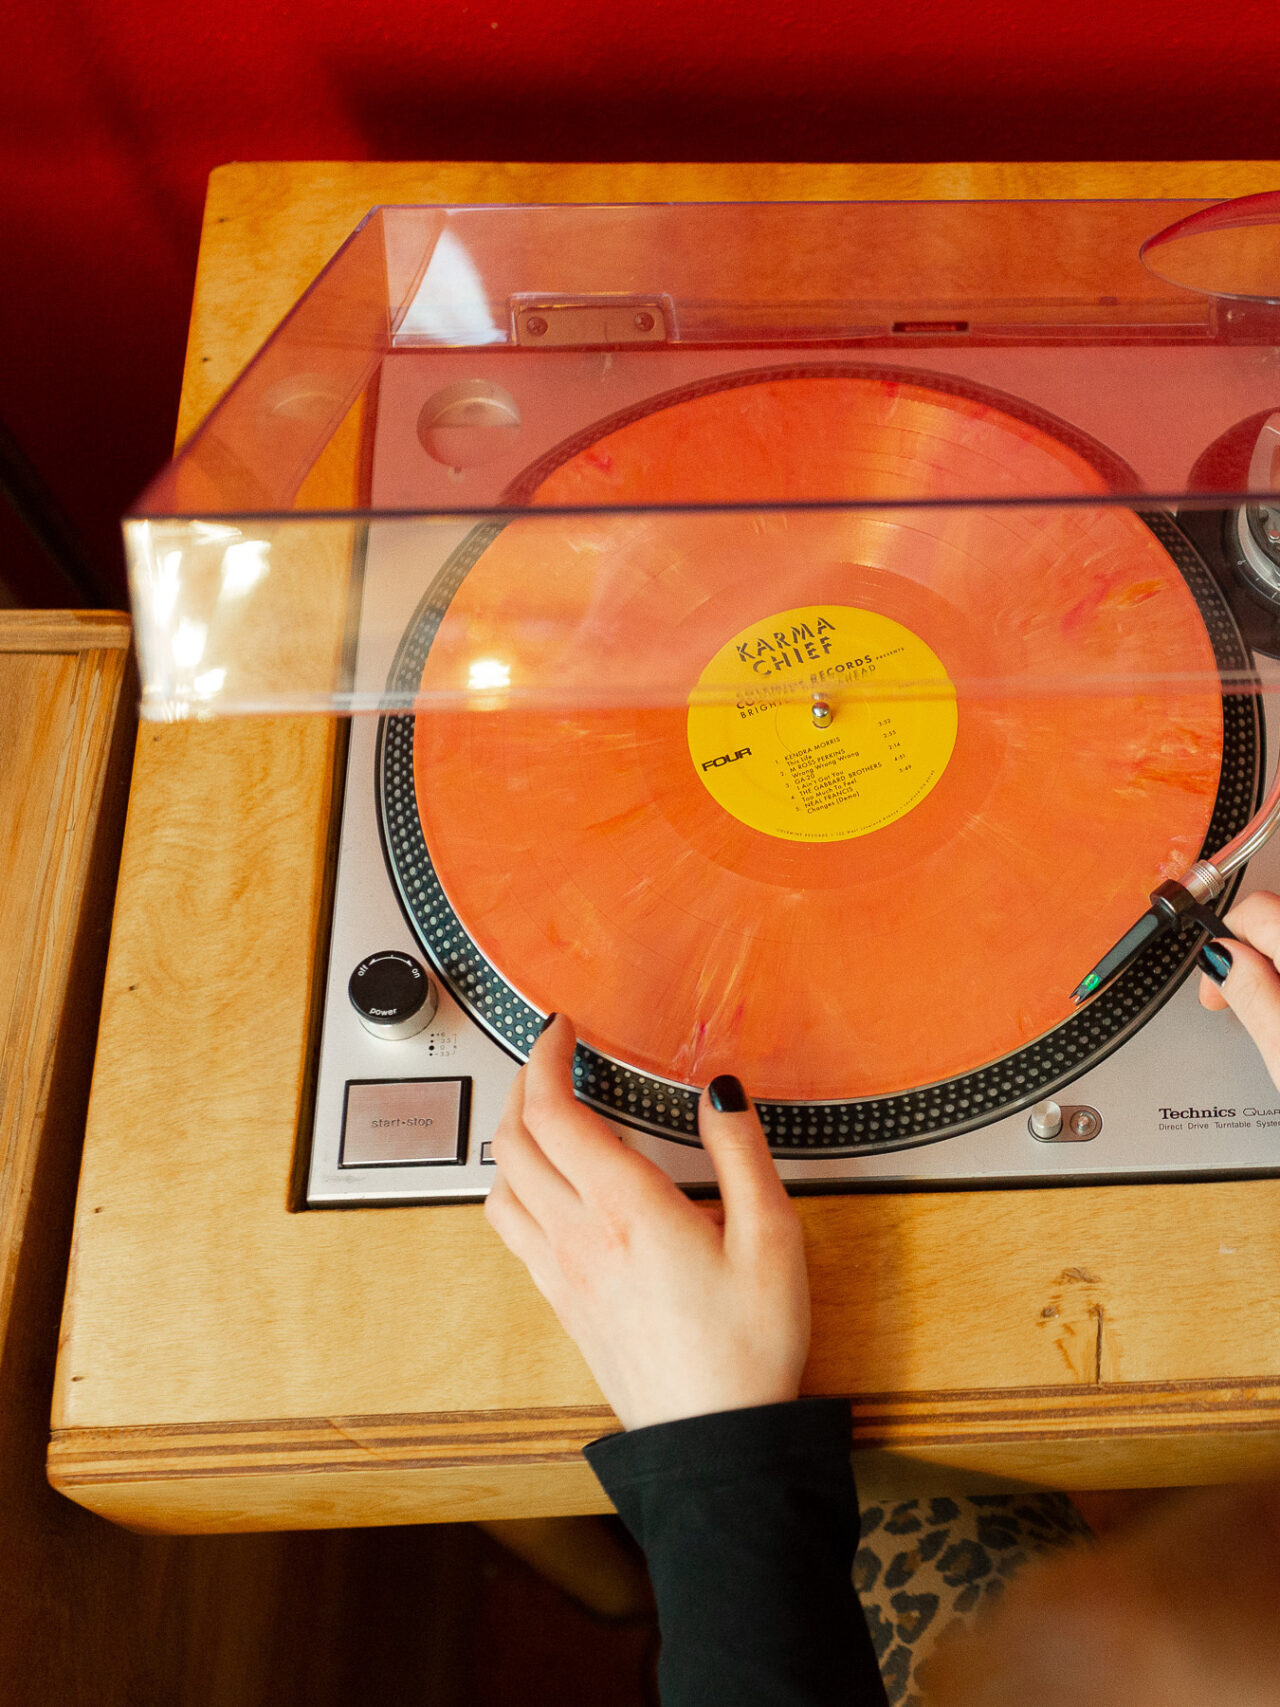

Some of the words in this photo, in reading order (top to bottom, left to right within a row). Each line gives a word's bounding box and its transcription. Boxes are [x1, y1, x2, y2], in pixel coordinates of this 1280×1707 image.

[736, 617, 836, 662] KARMA
[752, 636, 832, 676] CHIEF
[810, 655, 873, 683] RECORDS
[784, 747, 812, 760] KENDRA
[814, 737, 840, 750] MORRIS
[798, 759, 816, 769] ROSS
[817, 749, 845, 762] PERKINS
[702, 748, 752, 772] FOUR
[792, 768, 813, 778] Wrong
[816, 759, 836, 770] Wrong
[838, 751, 859, 762] Wrong
[799, 787, 811, 796] THE
[848, 762, 882, 778] BROTHERS
[805, 798, 822, 807] NEAL
[824, 787, 853, 800] FRANCIS
[815, 788, 832, 796] Much
[807, 800, 835, 814] Changes
[358, 964, 368, 976] off
[412, 968, 420, 978] on
[368, 1008, 398, 1016] power
[1158, 1106, 1236, 1120] Technics
